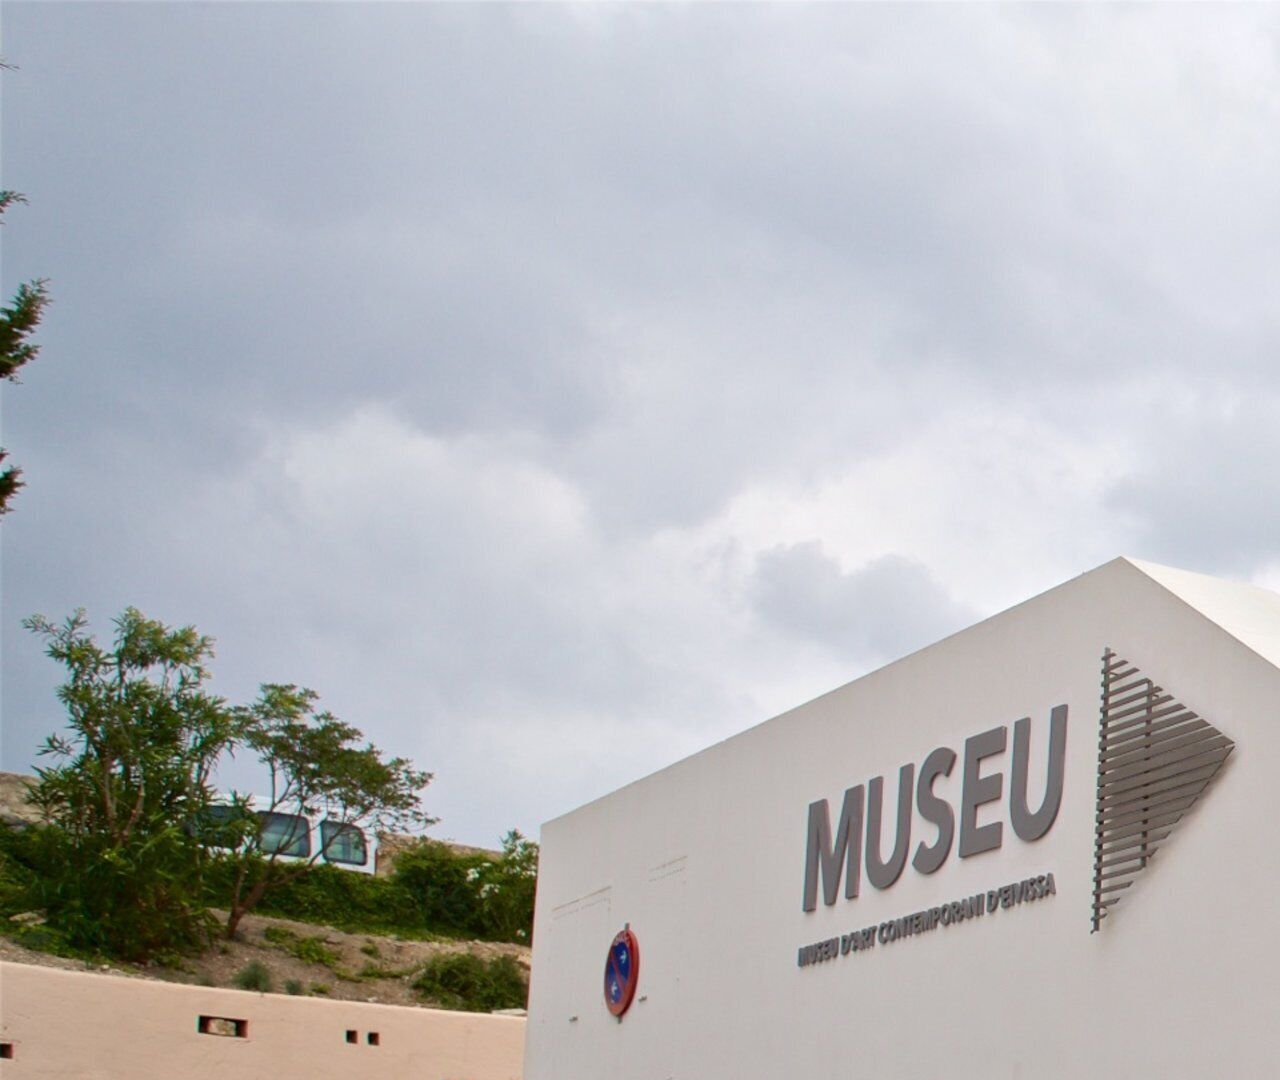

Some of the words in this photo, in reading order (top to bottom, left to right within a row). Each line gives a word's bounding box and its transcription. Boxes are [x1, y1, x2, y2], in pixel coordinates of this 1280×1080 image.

[803, 704, 1068, 912] MUSEU
[798, 937, 840, 967] MUSEU
[841, 925, 877, 956] D'ART
[877, 893, 985, 944] CONTEMPORANI
[986, 873, 1056, 913] D'EIVISSA
